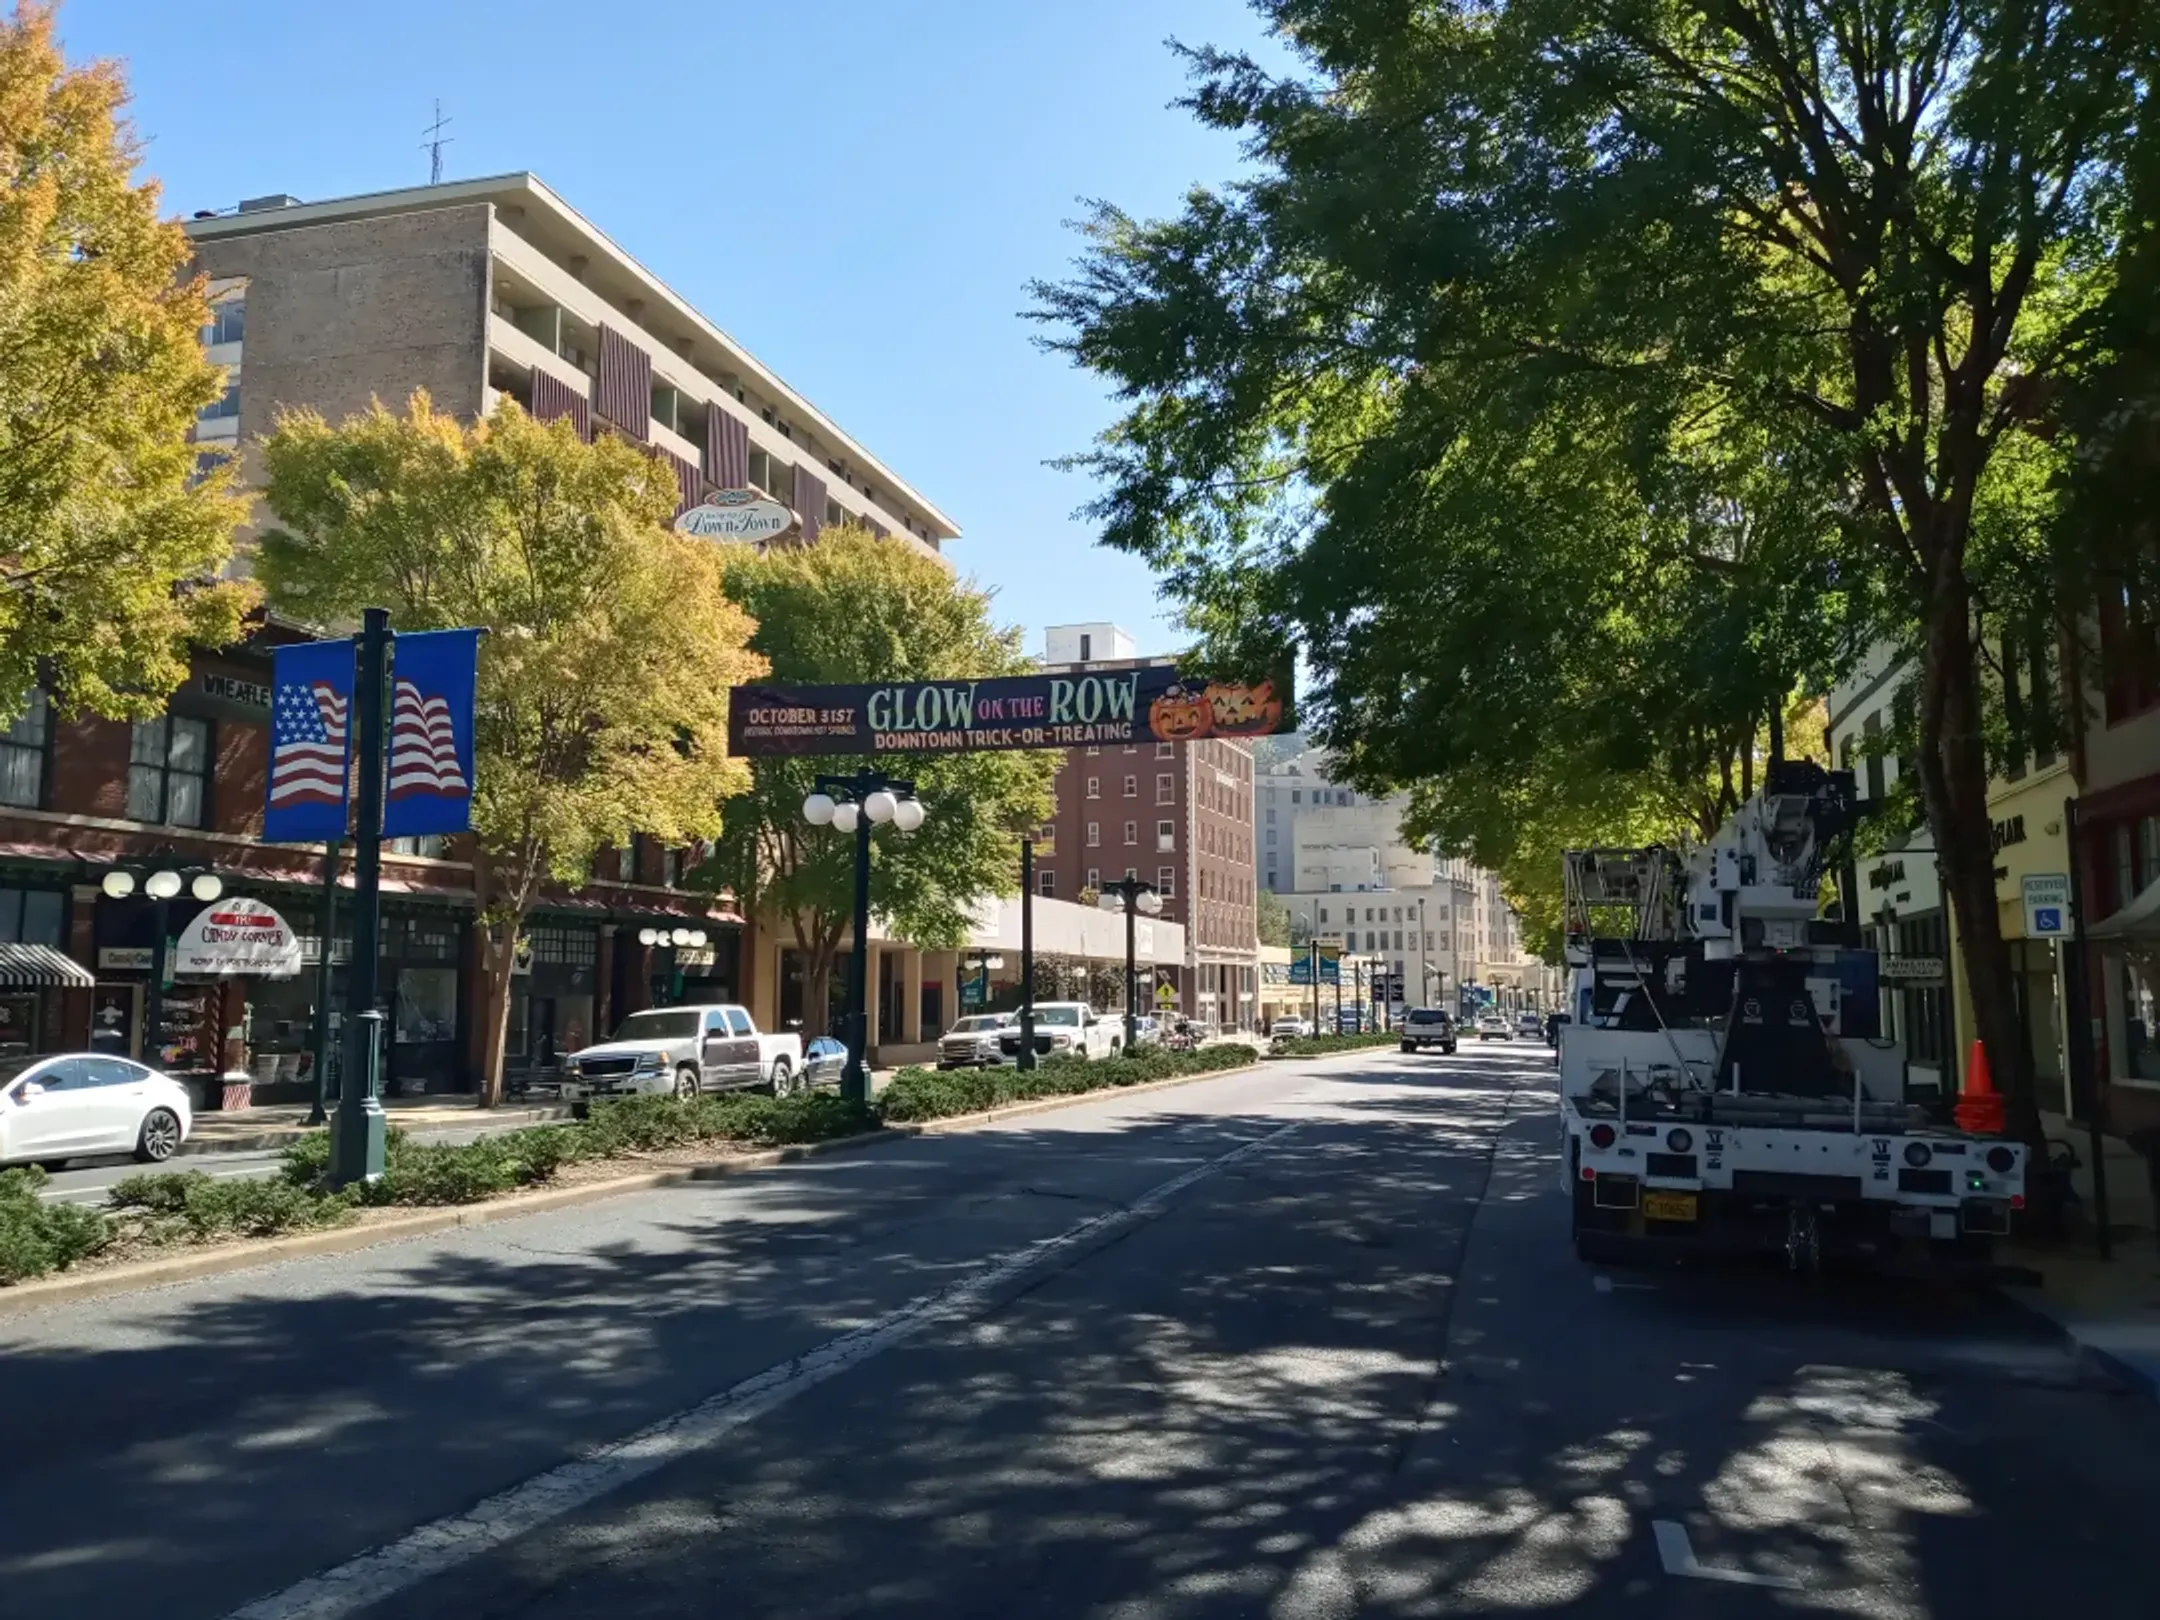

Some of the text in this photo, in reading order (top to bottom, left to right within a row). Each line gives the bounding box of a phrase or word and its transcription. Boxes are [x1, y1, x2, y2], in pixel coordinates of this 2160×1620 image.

[203, 673, 273, 706] WHEATLE
[867, 671, 1141, 732] GLOW ON THE ROW
[748, 707, 856, 724] OCTOBER 31ST
[874, 722, 1132, 750] DOWNTOWN TRICK-OR-TREATING
